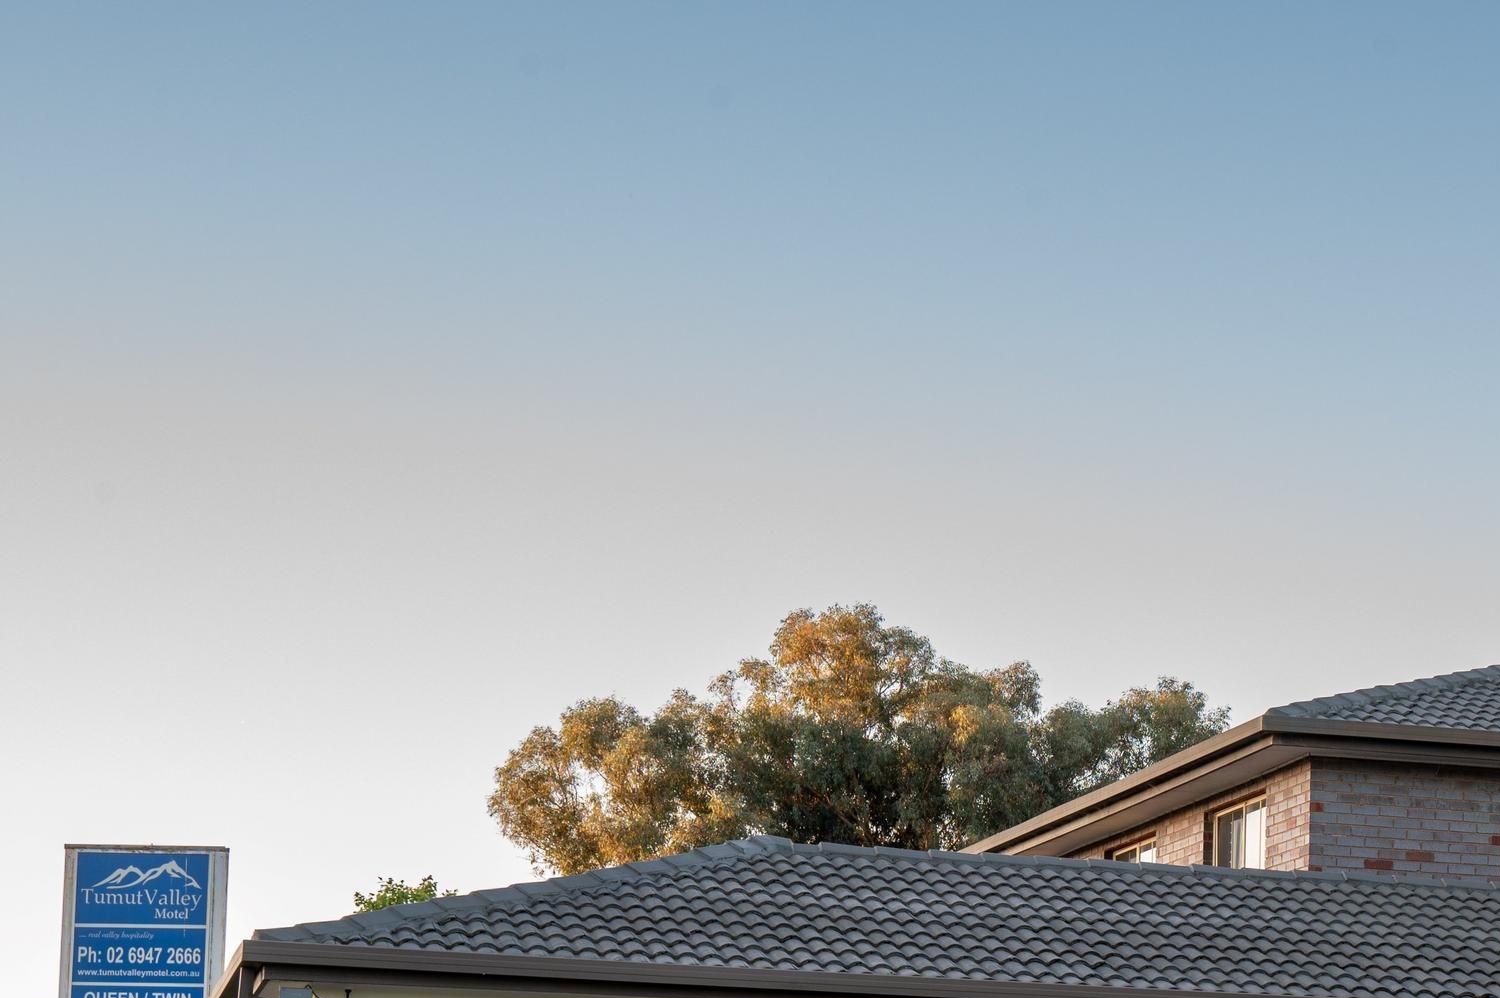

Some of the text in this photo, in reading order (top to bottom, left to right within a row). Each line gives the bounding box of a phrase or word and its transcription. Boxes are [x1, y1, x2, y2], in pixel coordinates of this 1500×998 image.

[154, 908, 189, 919] Motel
[101, 931, 120, 940] valley
[120, 931, 154, 940] hospitality
[77, 946, 201, 964] Ph: 02 6947 2666
[77, 969, 200, 978] www.tumutvalleymotel.com.au
